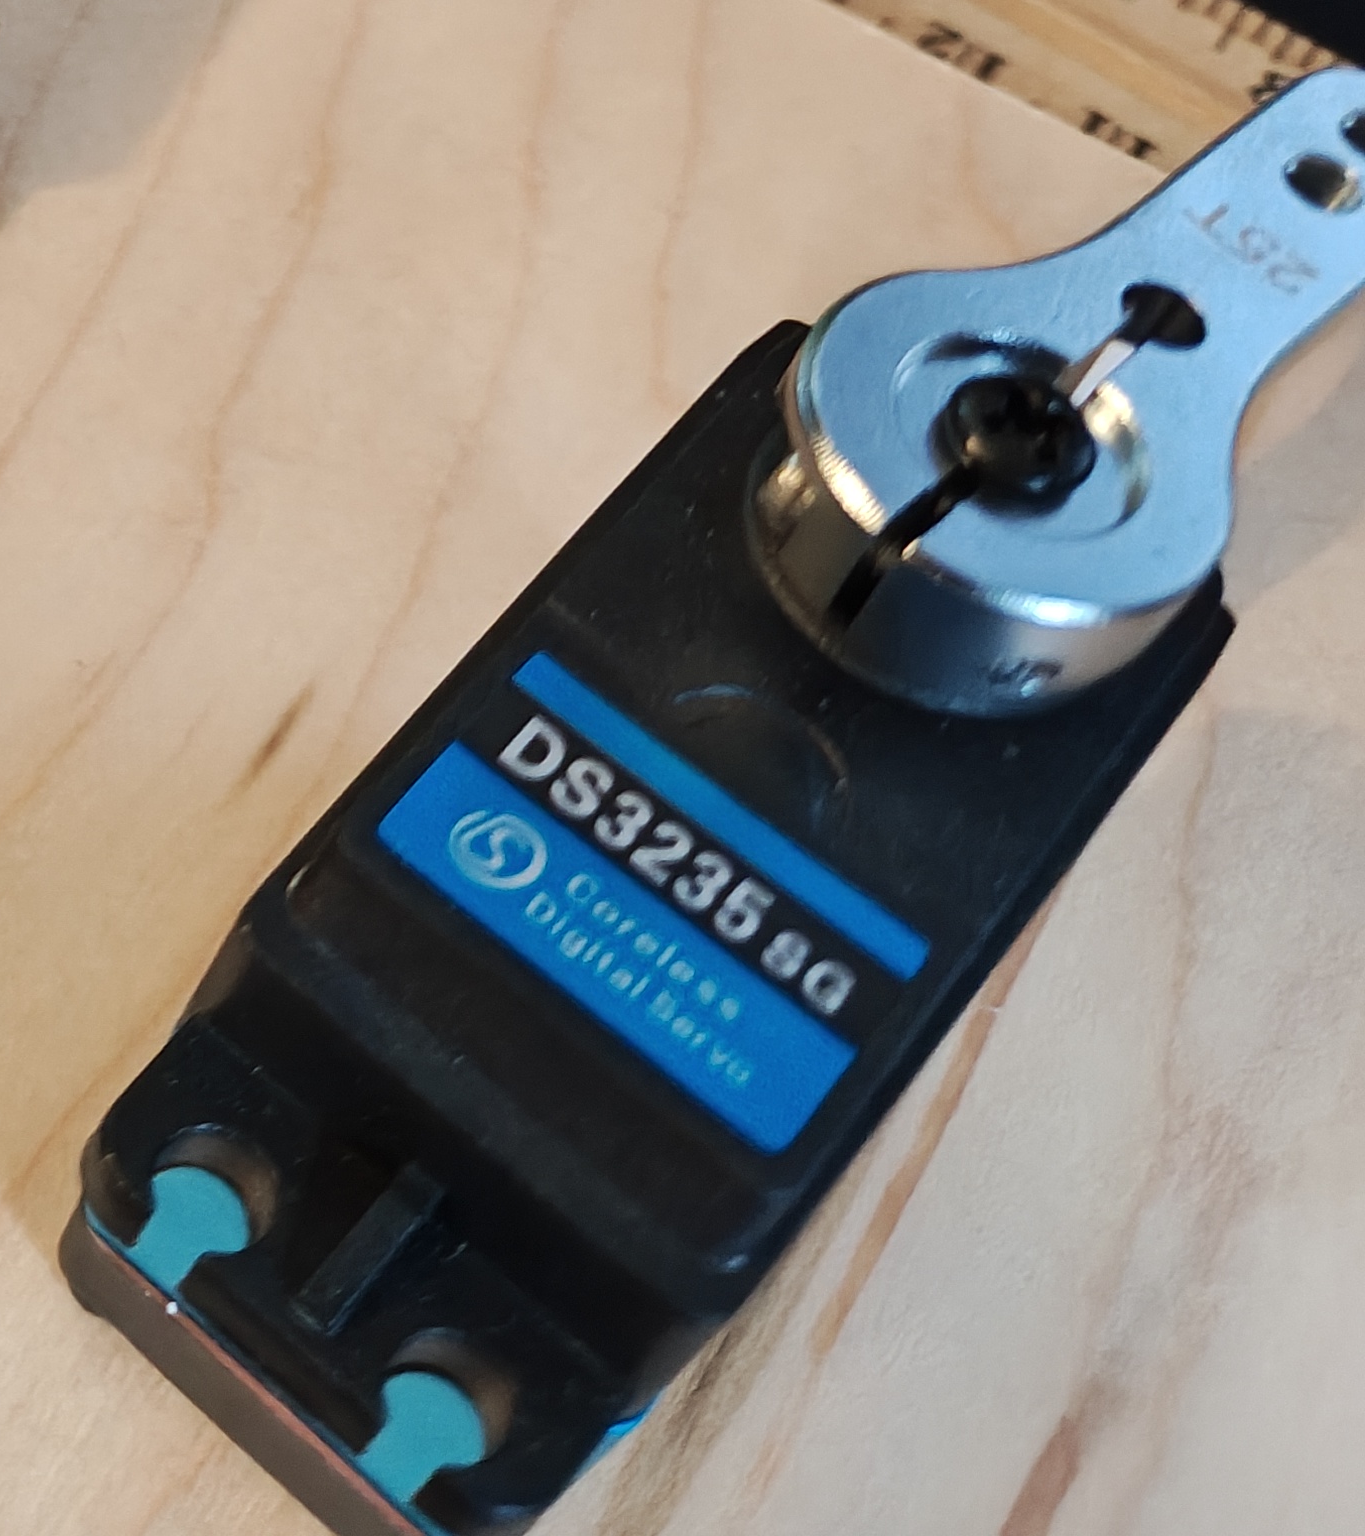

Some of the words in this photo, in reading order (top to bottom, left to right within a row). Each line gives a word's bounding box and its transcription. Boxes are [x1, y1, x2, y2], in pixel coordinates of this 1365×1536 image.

[917, 22, 1007, 83] 12
[497, 714, 776, 944] DS3235
[525, 890, 651, 1001] Digital
